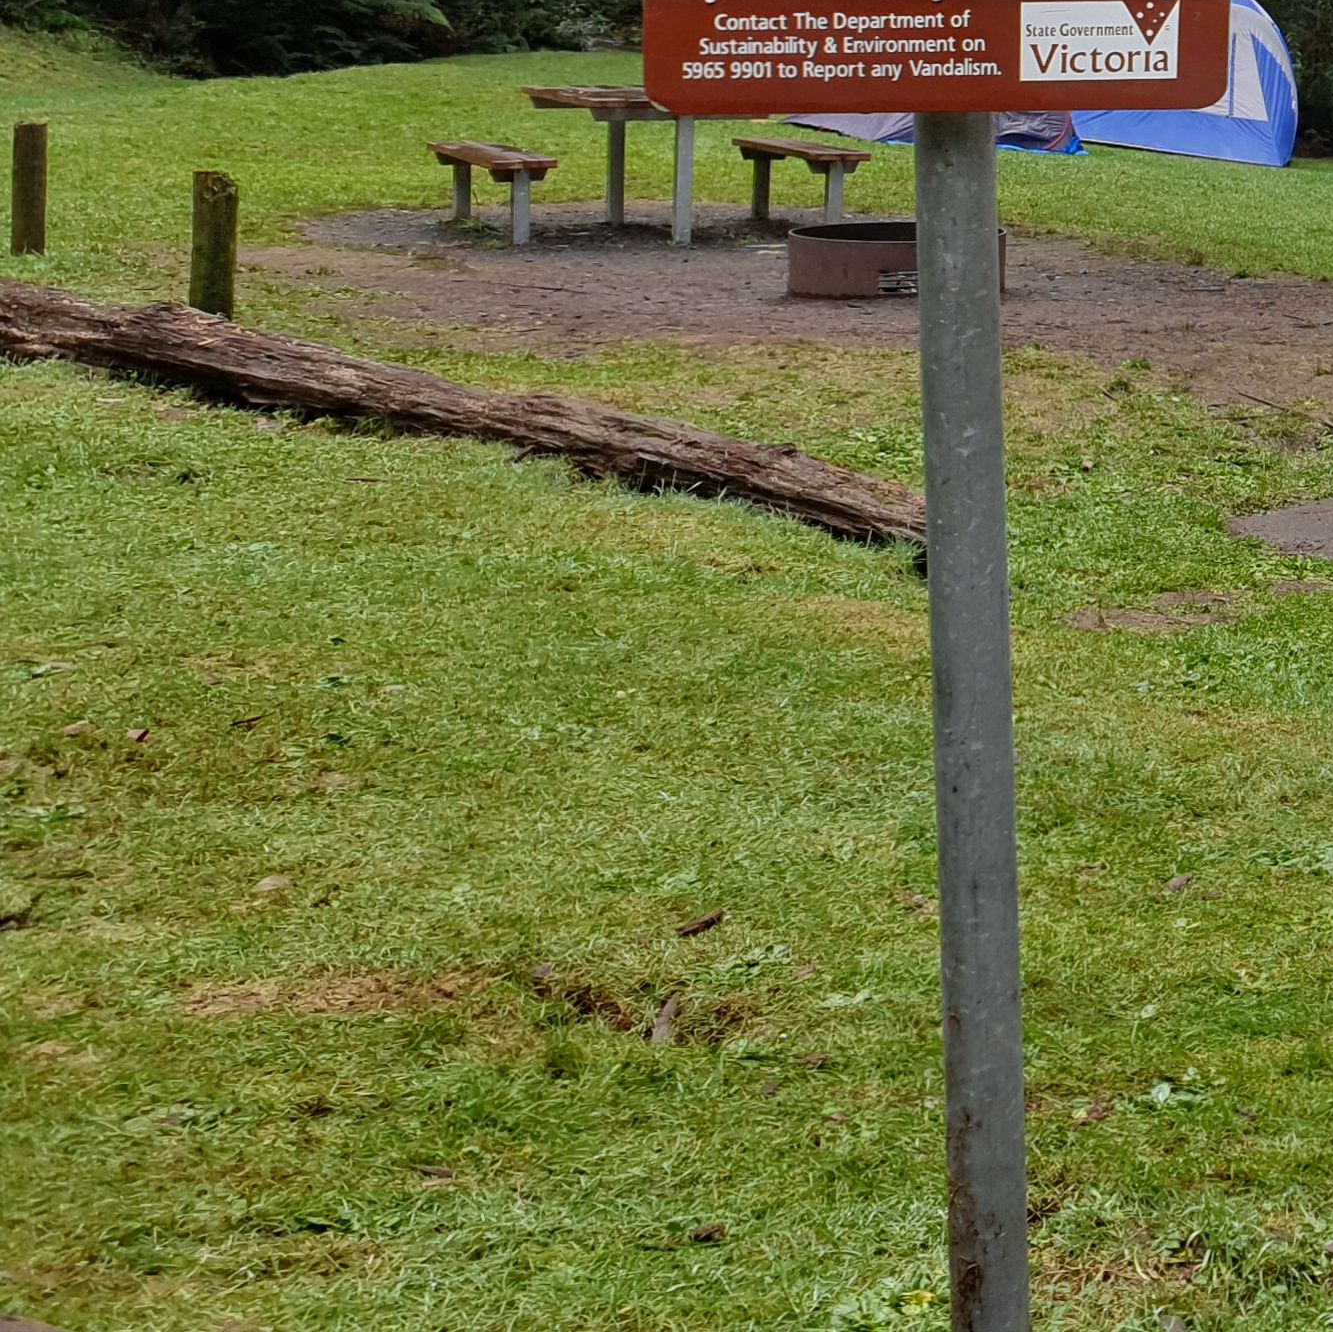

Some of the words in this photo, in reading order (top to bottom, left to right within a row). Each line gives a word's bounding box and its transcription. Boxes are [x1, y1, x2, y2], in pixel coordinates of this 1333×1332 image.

[714, 13, 788, 31] Contact
[793, 11, 829, 30] The
[833, 12, 945, 34] Department
[950, 9, 971, 28] of
[1025, 23, 1056, 37] State
[1059, 23, 1134, 37] Government
[699, 35, 818, 59] Sustainability
[823, 36, 838, 54] &
[843, 35, 956, 54] Environment
[962, 38, 986, 52] on
[1030, 44, 1169, 74] Victoria
[682, 61, 725, 79] 5965
[730, 61, 772, 79] 9901
[777, 62, 798, 79] to
[803, 60, 866, 82] Report
[871, 63, 903, 82] any
[909, 57, 1002, 77] Vandalism.
